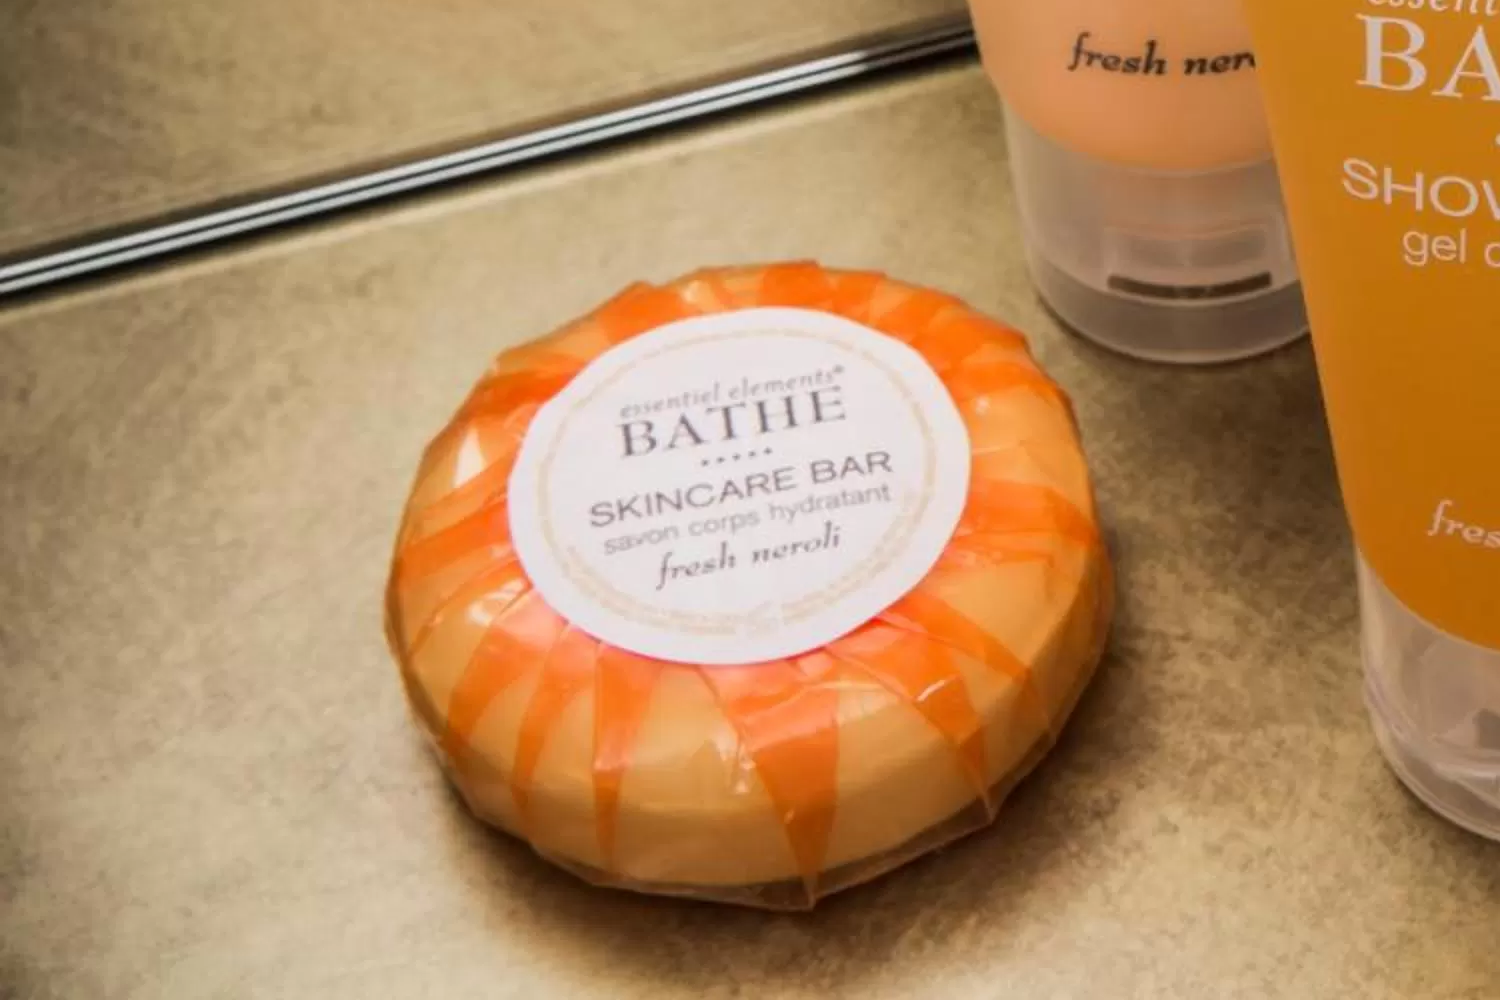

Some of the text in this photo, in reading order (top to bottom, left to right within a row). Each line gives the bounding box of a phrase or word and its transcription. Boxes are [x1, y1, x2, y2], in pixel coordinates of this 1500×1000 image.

[1067, 31, 1257, 76] fresh ner
[1402, 228, 1468, 266] gel
[616, 385, 847, 459] BATHE
[619, 381, 721, 419] essentiel
[589, 450, 894, 528] SKINCARE BAR
[603, 482, 892, 556] savon corps hydratant
[655, 541, 737, 591] fresh
[751, 519, 842, 566] neroli
